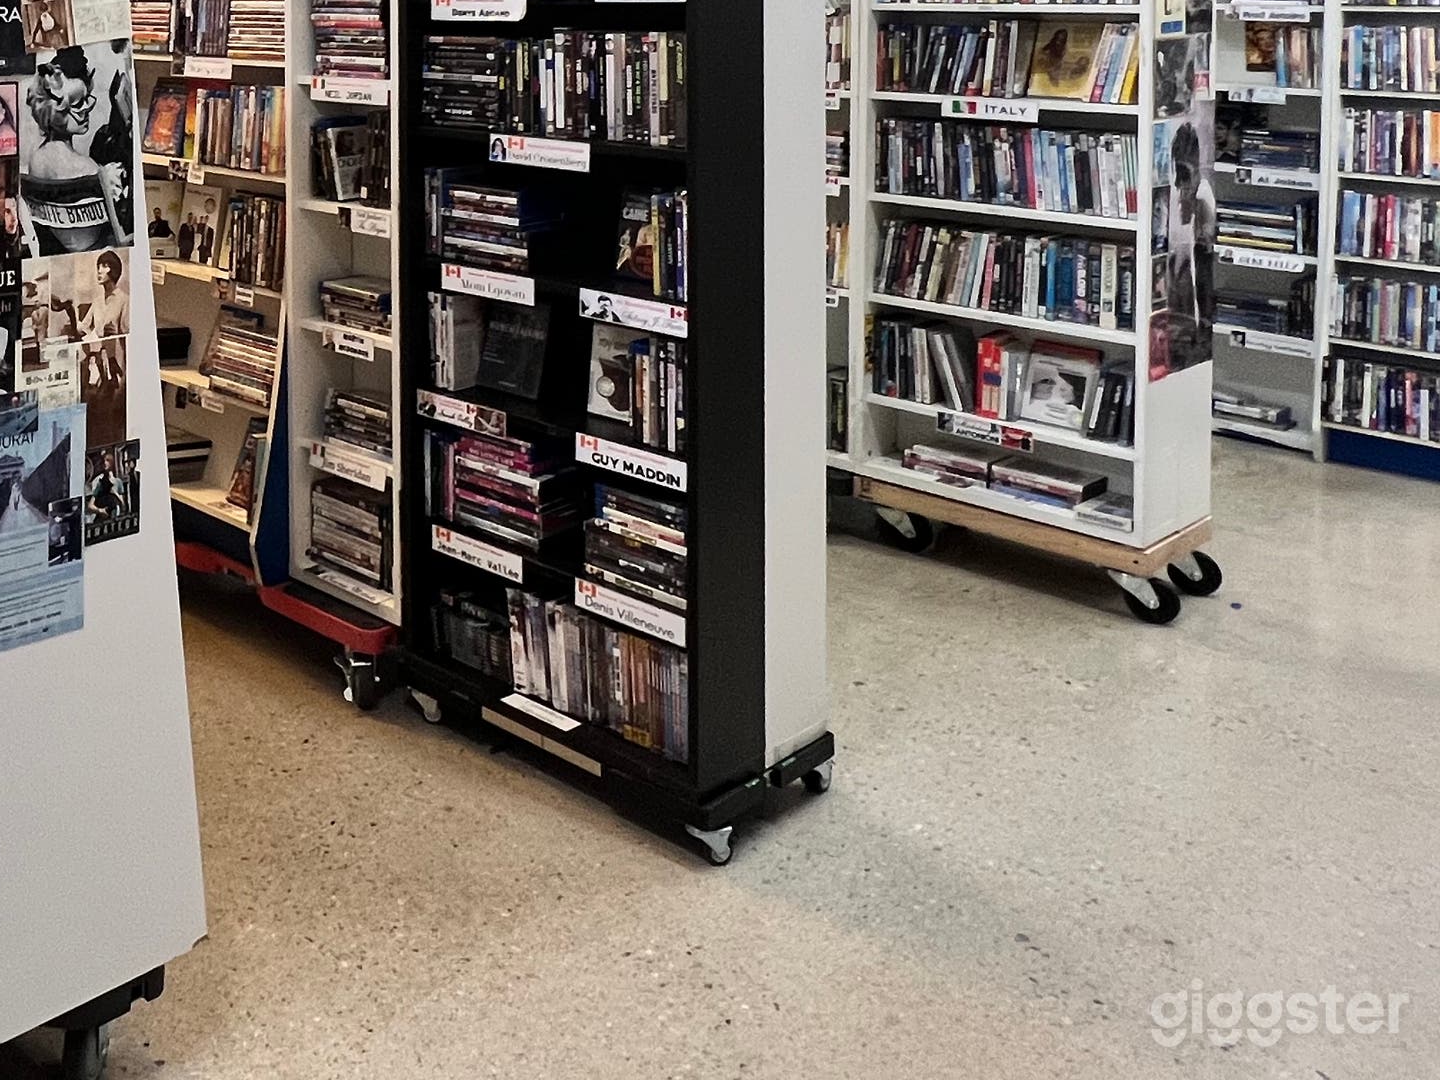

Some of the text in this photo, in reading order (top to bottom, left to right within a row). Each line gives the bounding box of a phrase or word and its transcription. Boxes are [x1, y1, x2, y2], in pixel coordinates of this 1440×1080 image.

[324, 90, 372, 101] NEIL JORDAN
[985, 104, 1028, 116] ITALY
[533, 153, 586, 170] Cronenberg
[336, 462, 371, 482] Sheridan
[591, 451, 681, 487] GUY MADDIN
[437, 541, 482, 566] Jean-Marc
[584, 594, 675, 639] Denis Villeneuve
